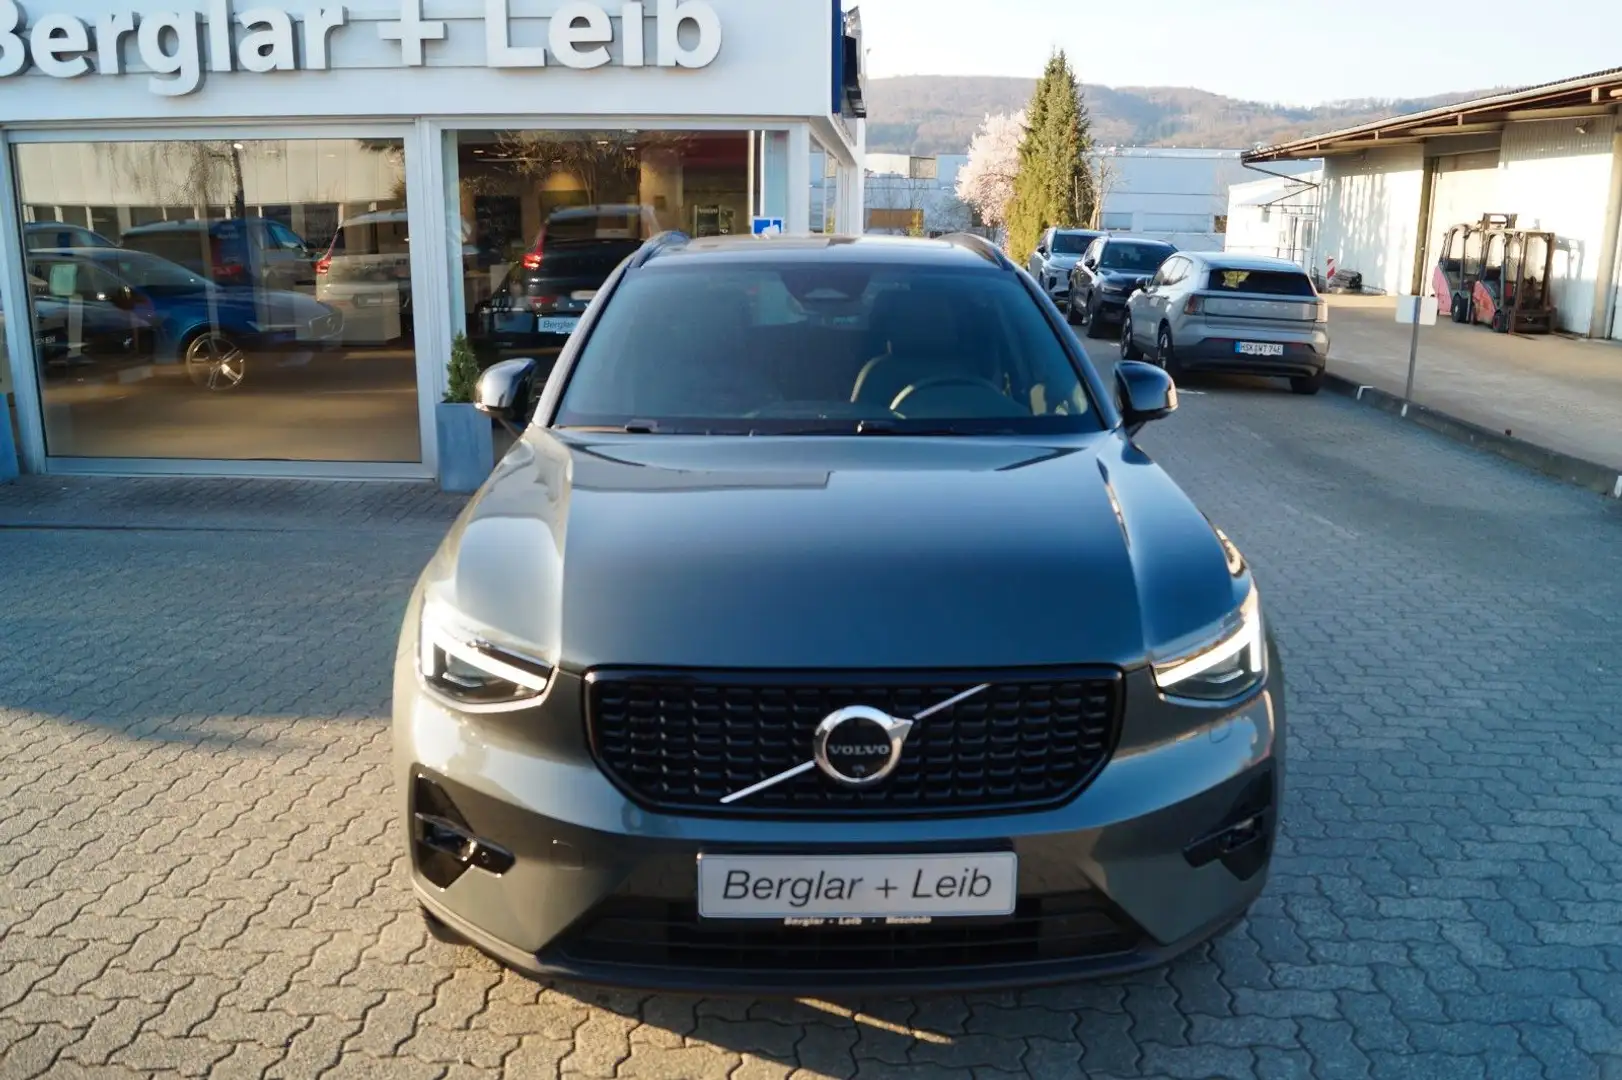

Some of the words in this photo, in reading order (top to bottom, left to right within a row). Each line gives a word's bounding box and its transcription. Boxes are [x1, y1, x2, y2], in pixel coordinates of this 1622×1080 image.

[377, 0, 447, 66] +
[485, 0, 723, 69] Leib
[828, 744, 890, 756] VOLVO
[722, 869, 863, 907] Berglar
[875, 878, 898, 899] +
[911, 867, 992, 899] Leib
